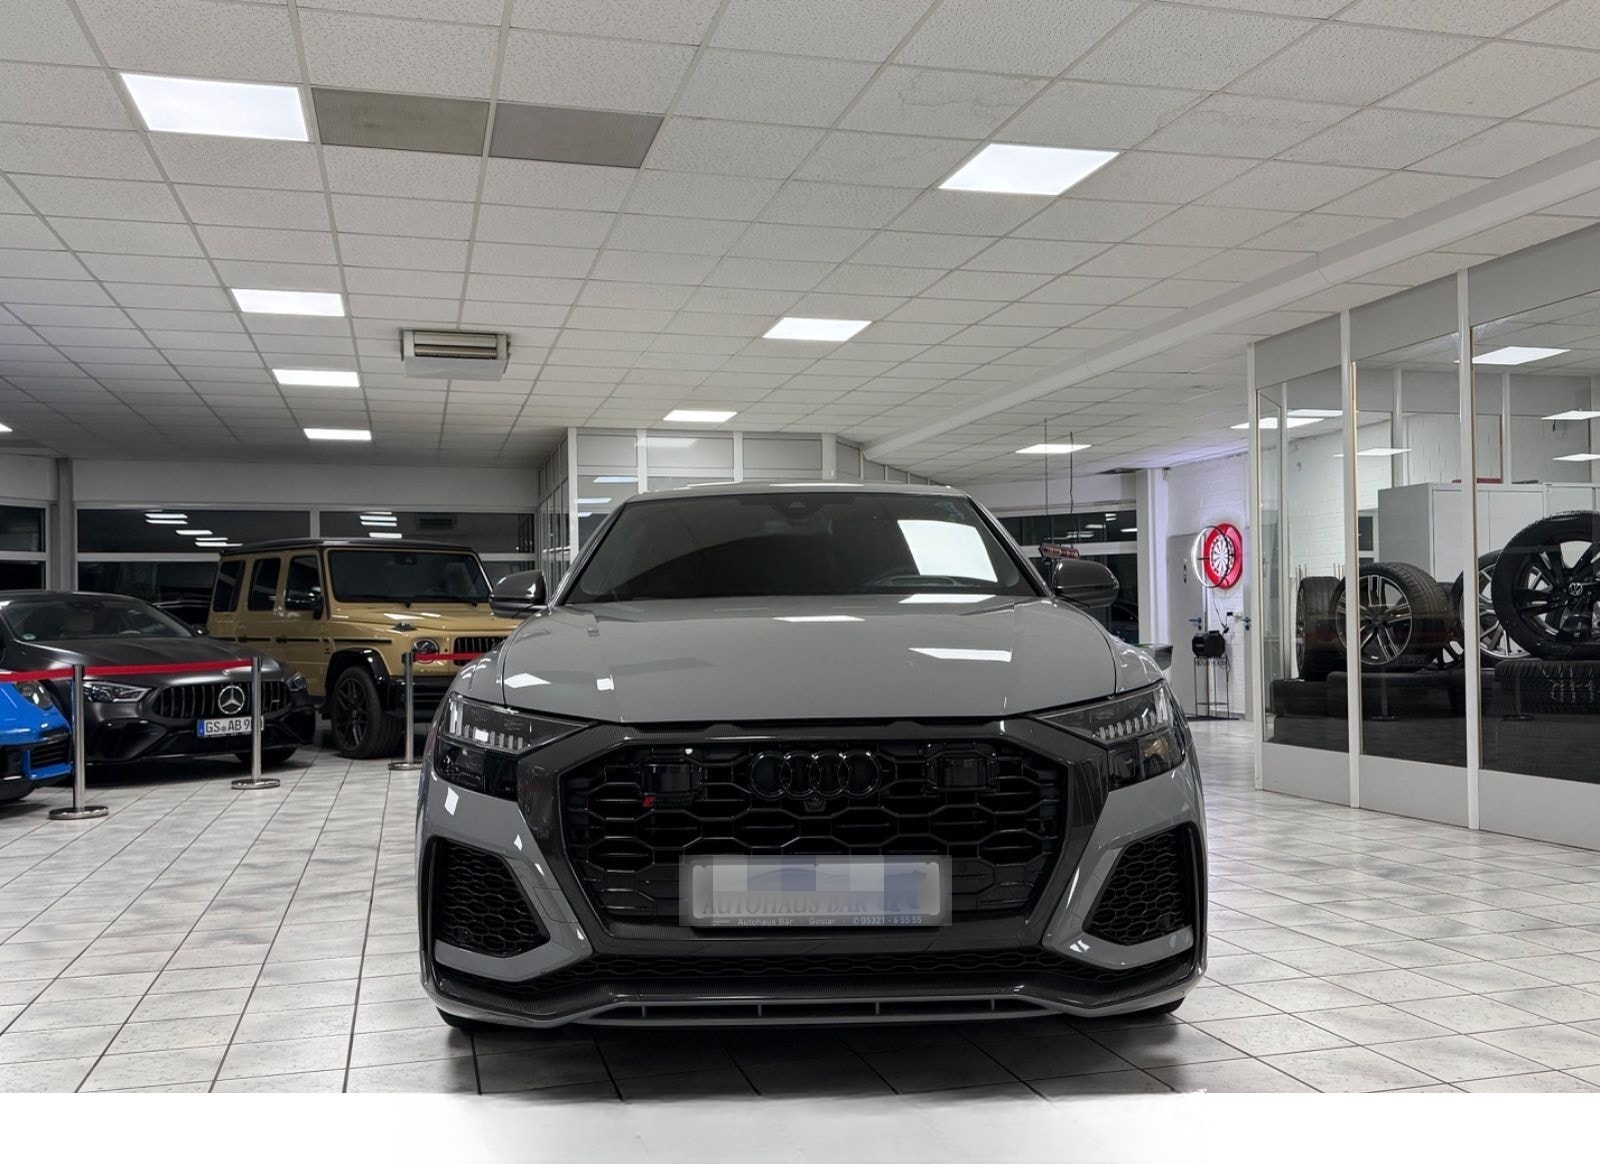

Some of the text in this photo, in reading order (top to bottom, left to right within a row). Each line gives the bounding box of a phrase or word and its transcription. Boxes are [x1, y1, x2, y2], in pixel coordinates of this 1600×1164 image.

[205, 721, 220, 733] GS
[228, 719, 242, 732] AB
[702, 895, 820, 914] AUTOHAUS
[737, 918, 776, 926] Autohaus
[809, 916, 835, 925] Goslar
